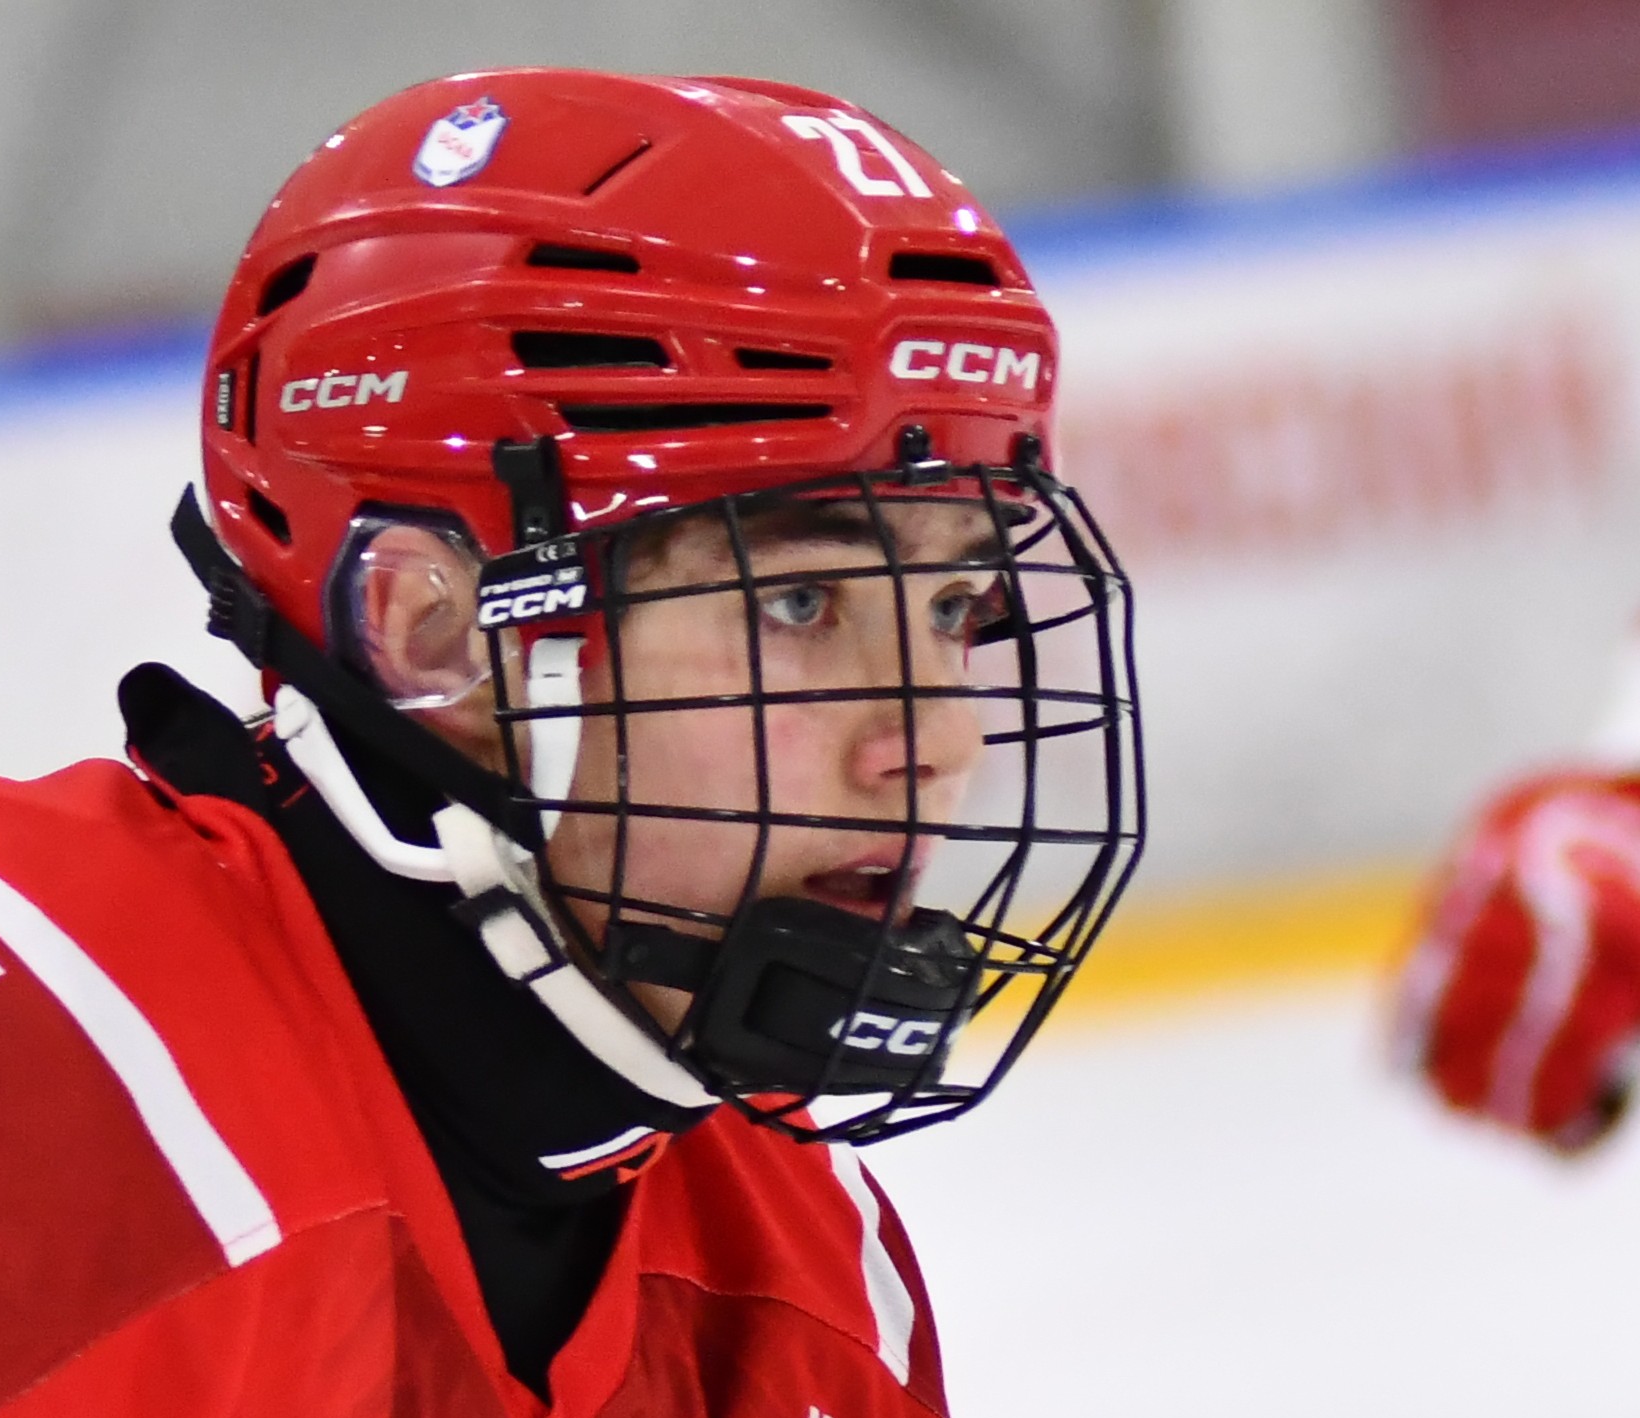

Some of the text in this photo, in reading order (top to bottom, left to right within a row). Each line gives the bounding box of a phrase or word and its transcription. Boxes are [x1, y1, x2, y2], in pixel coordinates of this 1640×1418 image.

[781, 109, 934, 198] 27
[888, 340, 1041, 389] CCM
[280, 371, 409, 413] CCM
[478, 585, 587, 625] CCM
